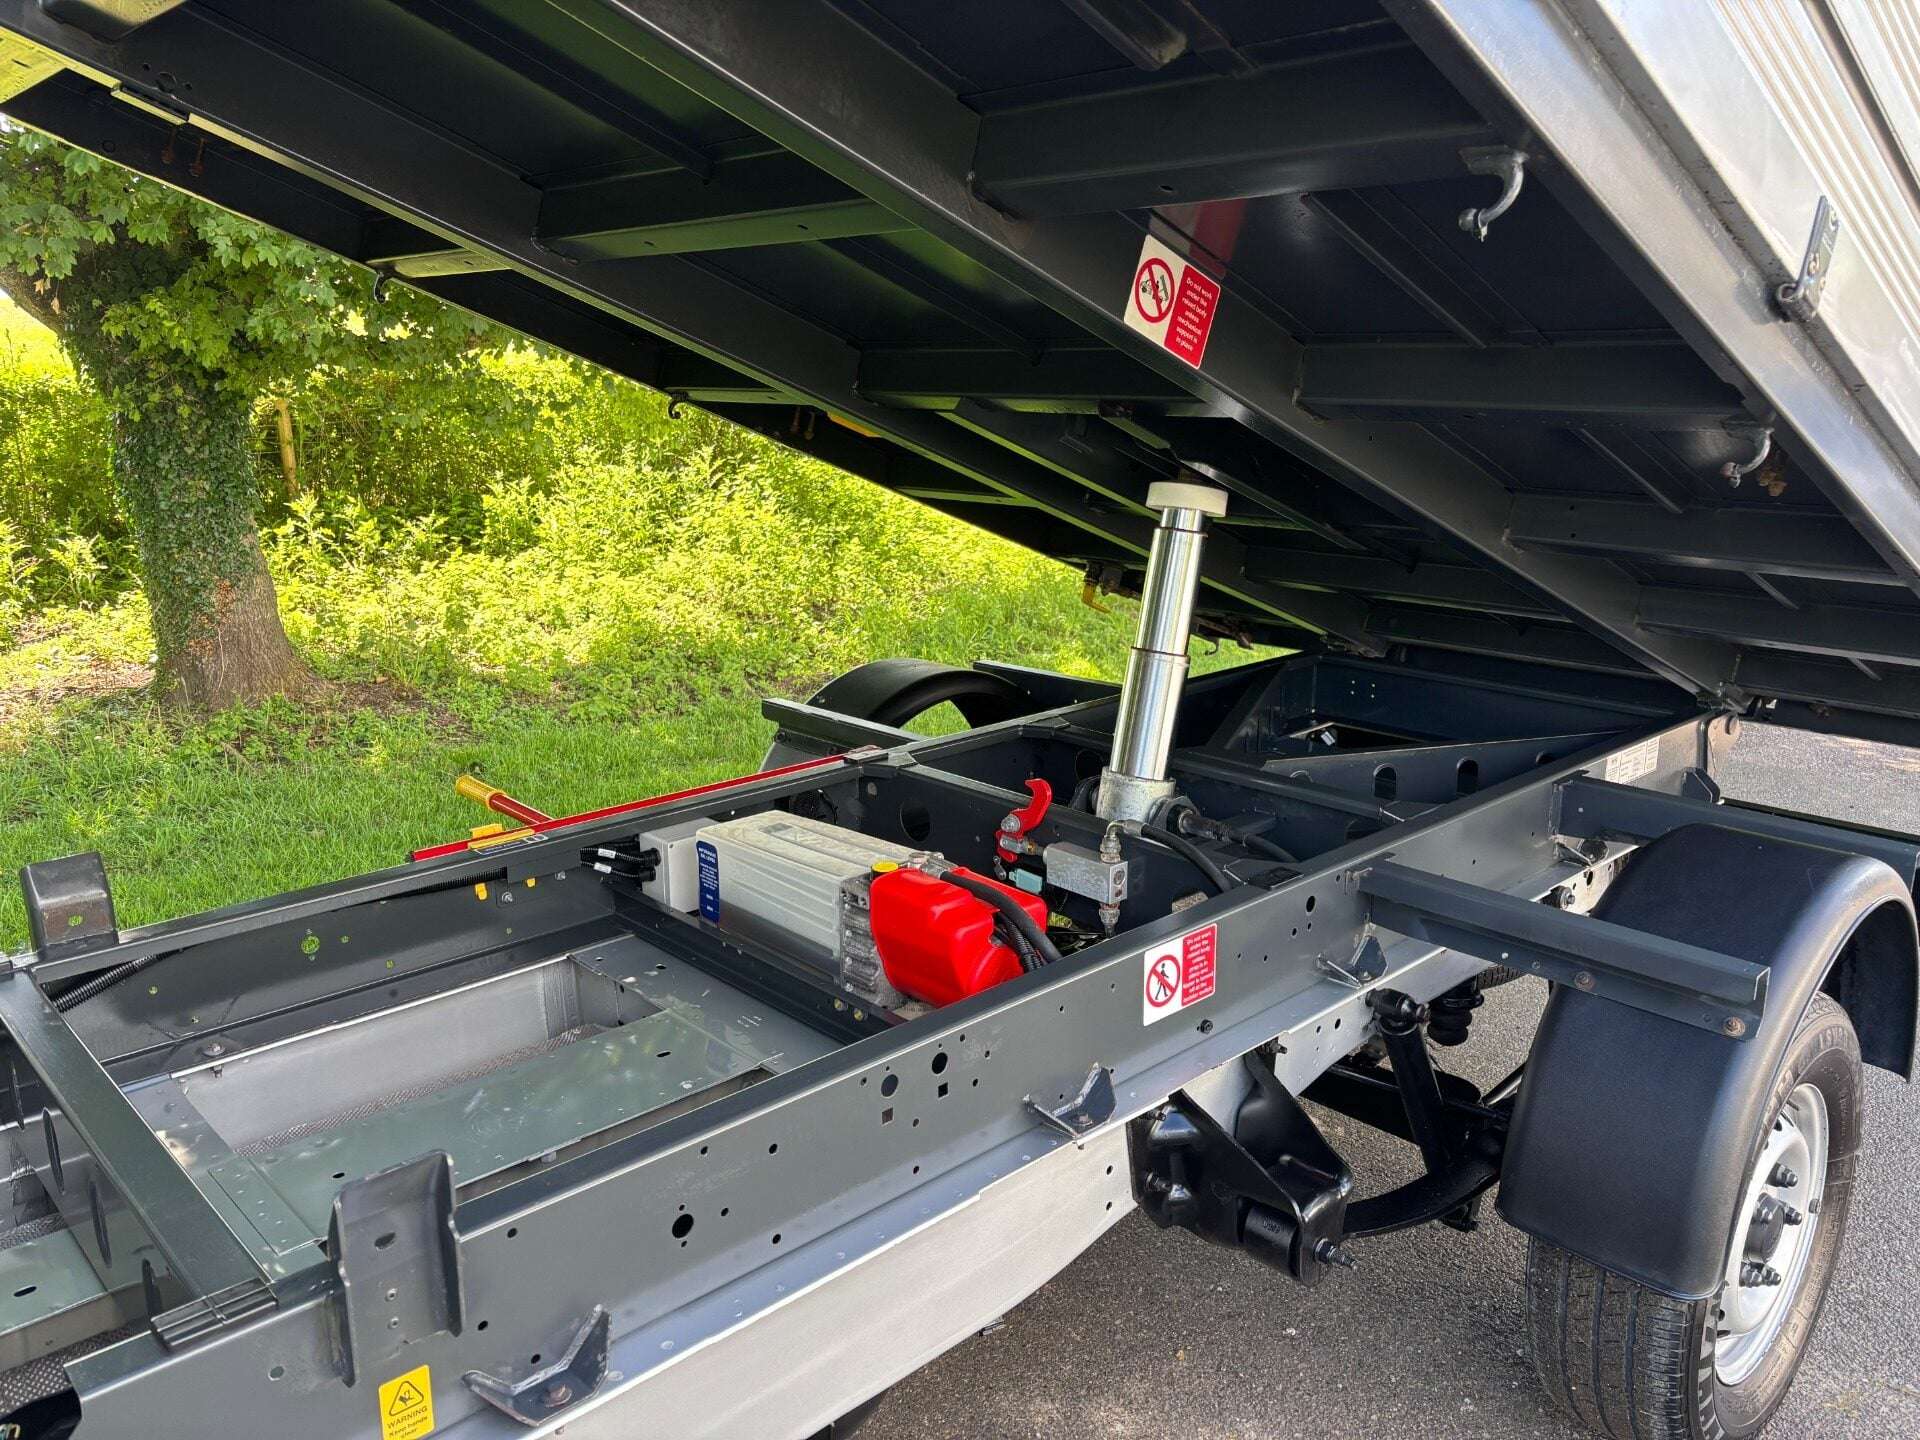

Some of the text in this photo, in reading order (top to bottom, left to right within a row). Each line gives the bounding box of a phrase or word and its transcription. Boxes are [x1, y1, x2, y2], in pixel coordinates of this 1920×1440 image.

[1202, 288, 1212, 300] work
[1177, 316, 1202, 335] mechanical
[387, 1405, 427, 1429] WARNING
